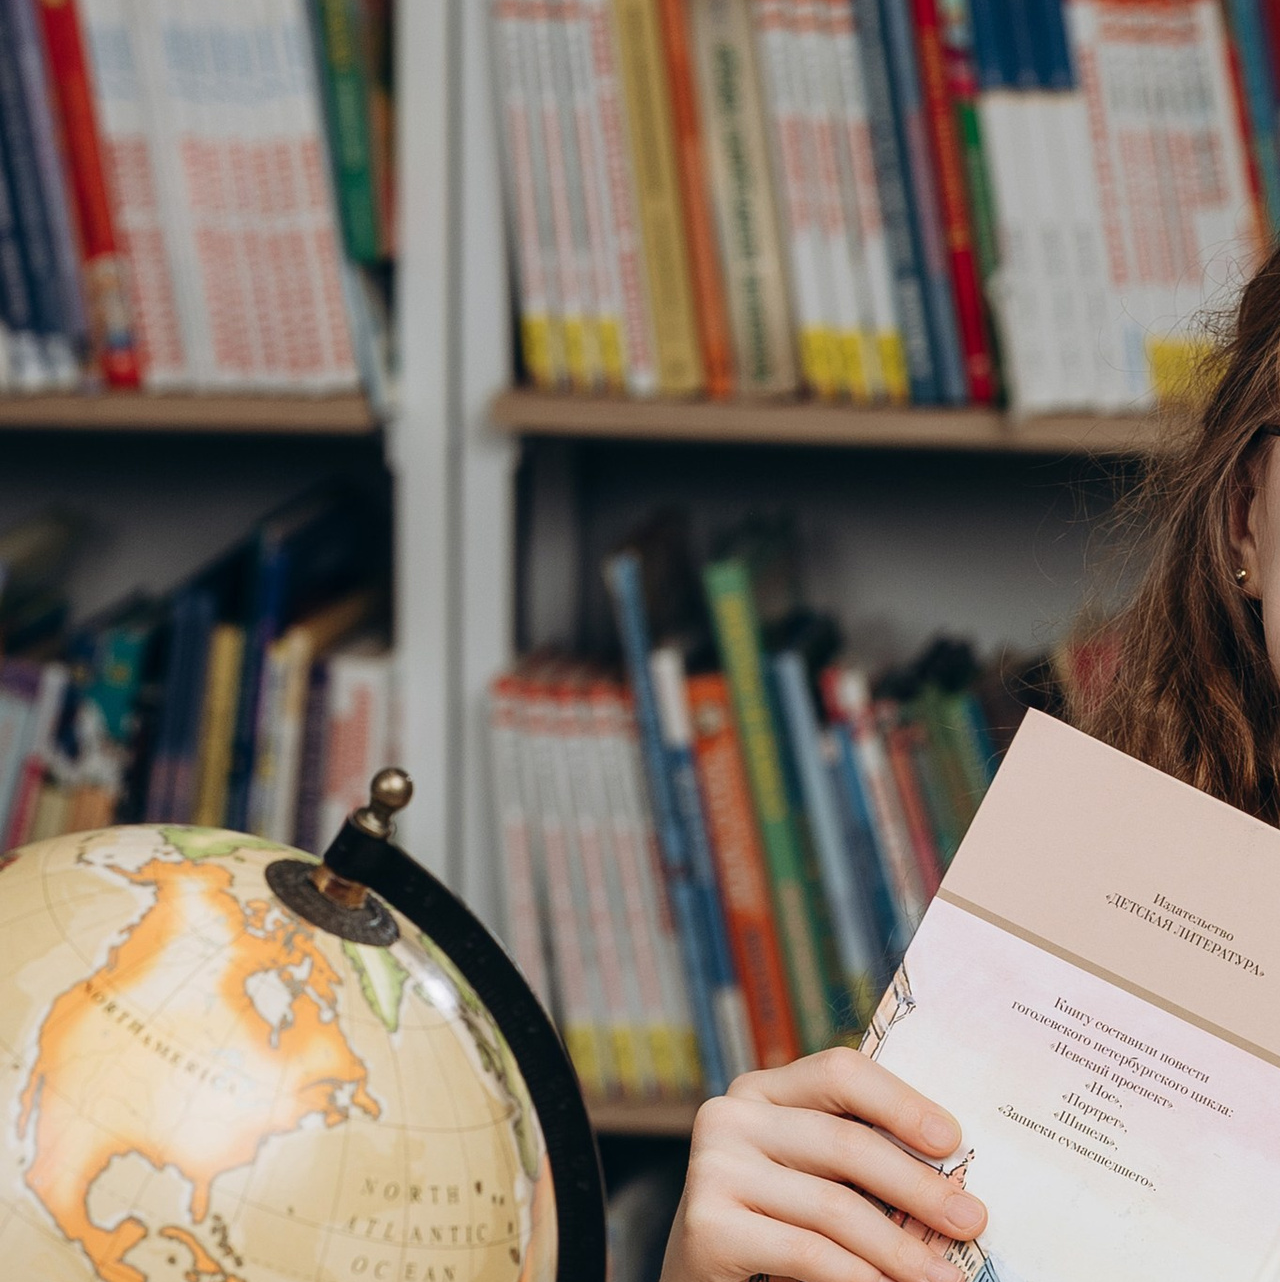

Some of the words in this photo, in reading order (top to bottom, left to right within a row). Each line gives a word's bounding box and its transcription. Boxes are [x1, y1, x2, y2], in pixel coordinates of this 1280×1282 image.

[1105, 892, 1173, 932] «ДЕТСКАЯ
[1173, 924, 1265, 977] ЛИТЕРАТУРА»
[1153, 893, 1234, 942] Издательство
[1011, 1000, 1092, 1046] гоголевского
[1093, 1041, 1189, 1096] петербургского
[1190, 1088, 1235, 1118] цикла:
[1050, 1040, 1109, 1078] «Невский
[1053, 996, 1095, 1027] Книгу
[1094, 1019, 1158, 1058] составили
[1159, 1052, 1210, 1084] повести
[1061, 1091, 1128, 1133] «Портрет»,
[1084, 1081, 1123, 1109] «Нос»,
[998, 1103, 1057, 1141] «Записки
[1057, 1133, 1157, 1192] сумасшедшего».
[1053, 1109, 1119, 1151] «Шинель»,
[361, 1177, 461, 1205] NORTH
[345, 1215, 490, 1245] ATLANTIC
